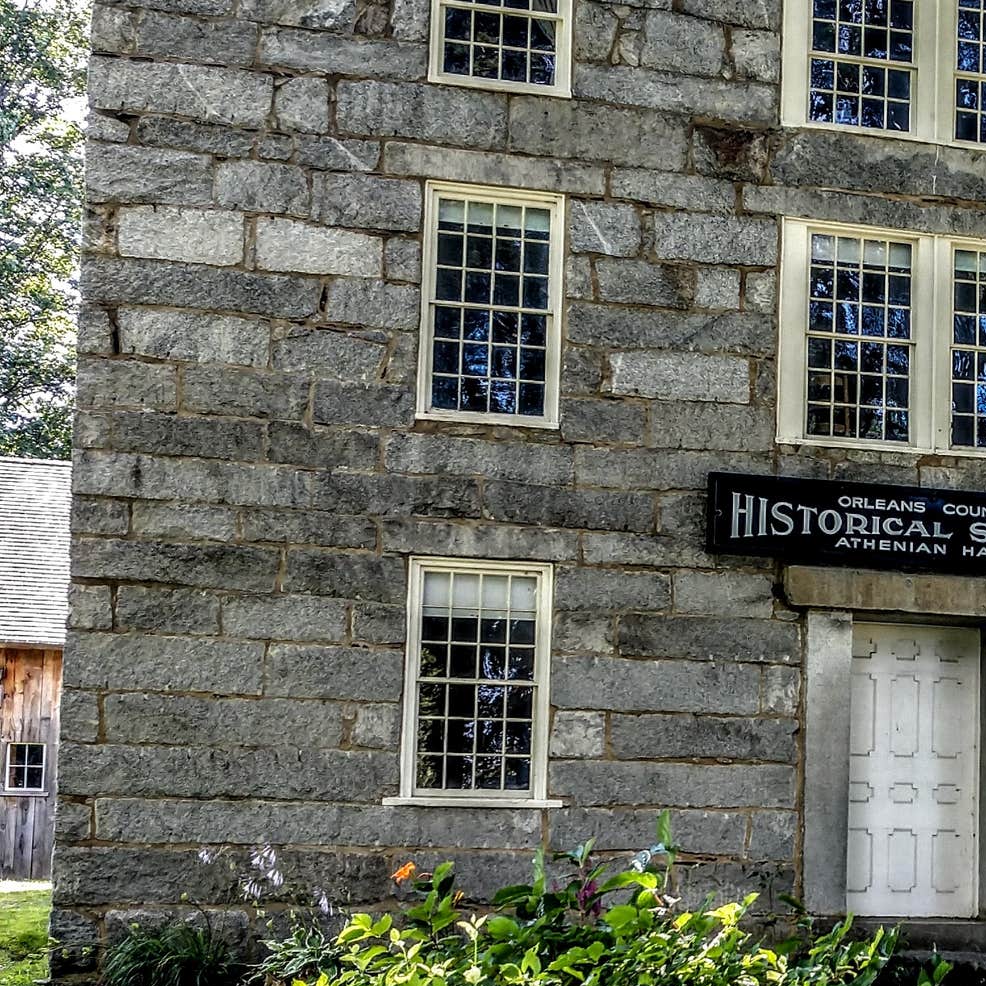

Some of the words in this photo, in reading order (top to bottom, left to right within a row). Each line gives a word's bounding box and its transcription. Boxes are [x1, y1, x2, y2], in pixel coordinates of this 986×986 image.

[837, 495, 927, 514] ORLEANS
[730, 491, 953, 540] HISTORICAL
[834, 536, 948, 556] ATHENIAN
